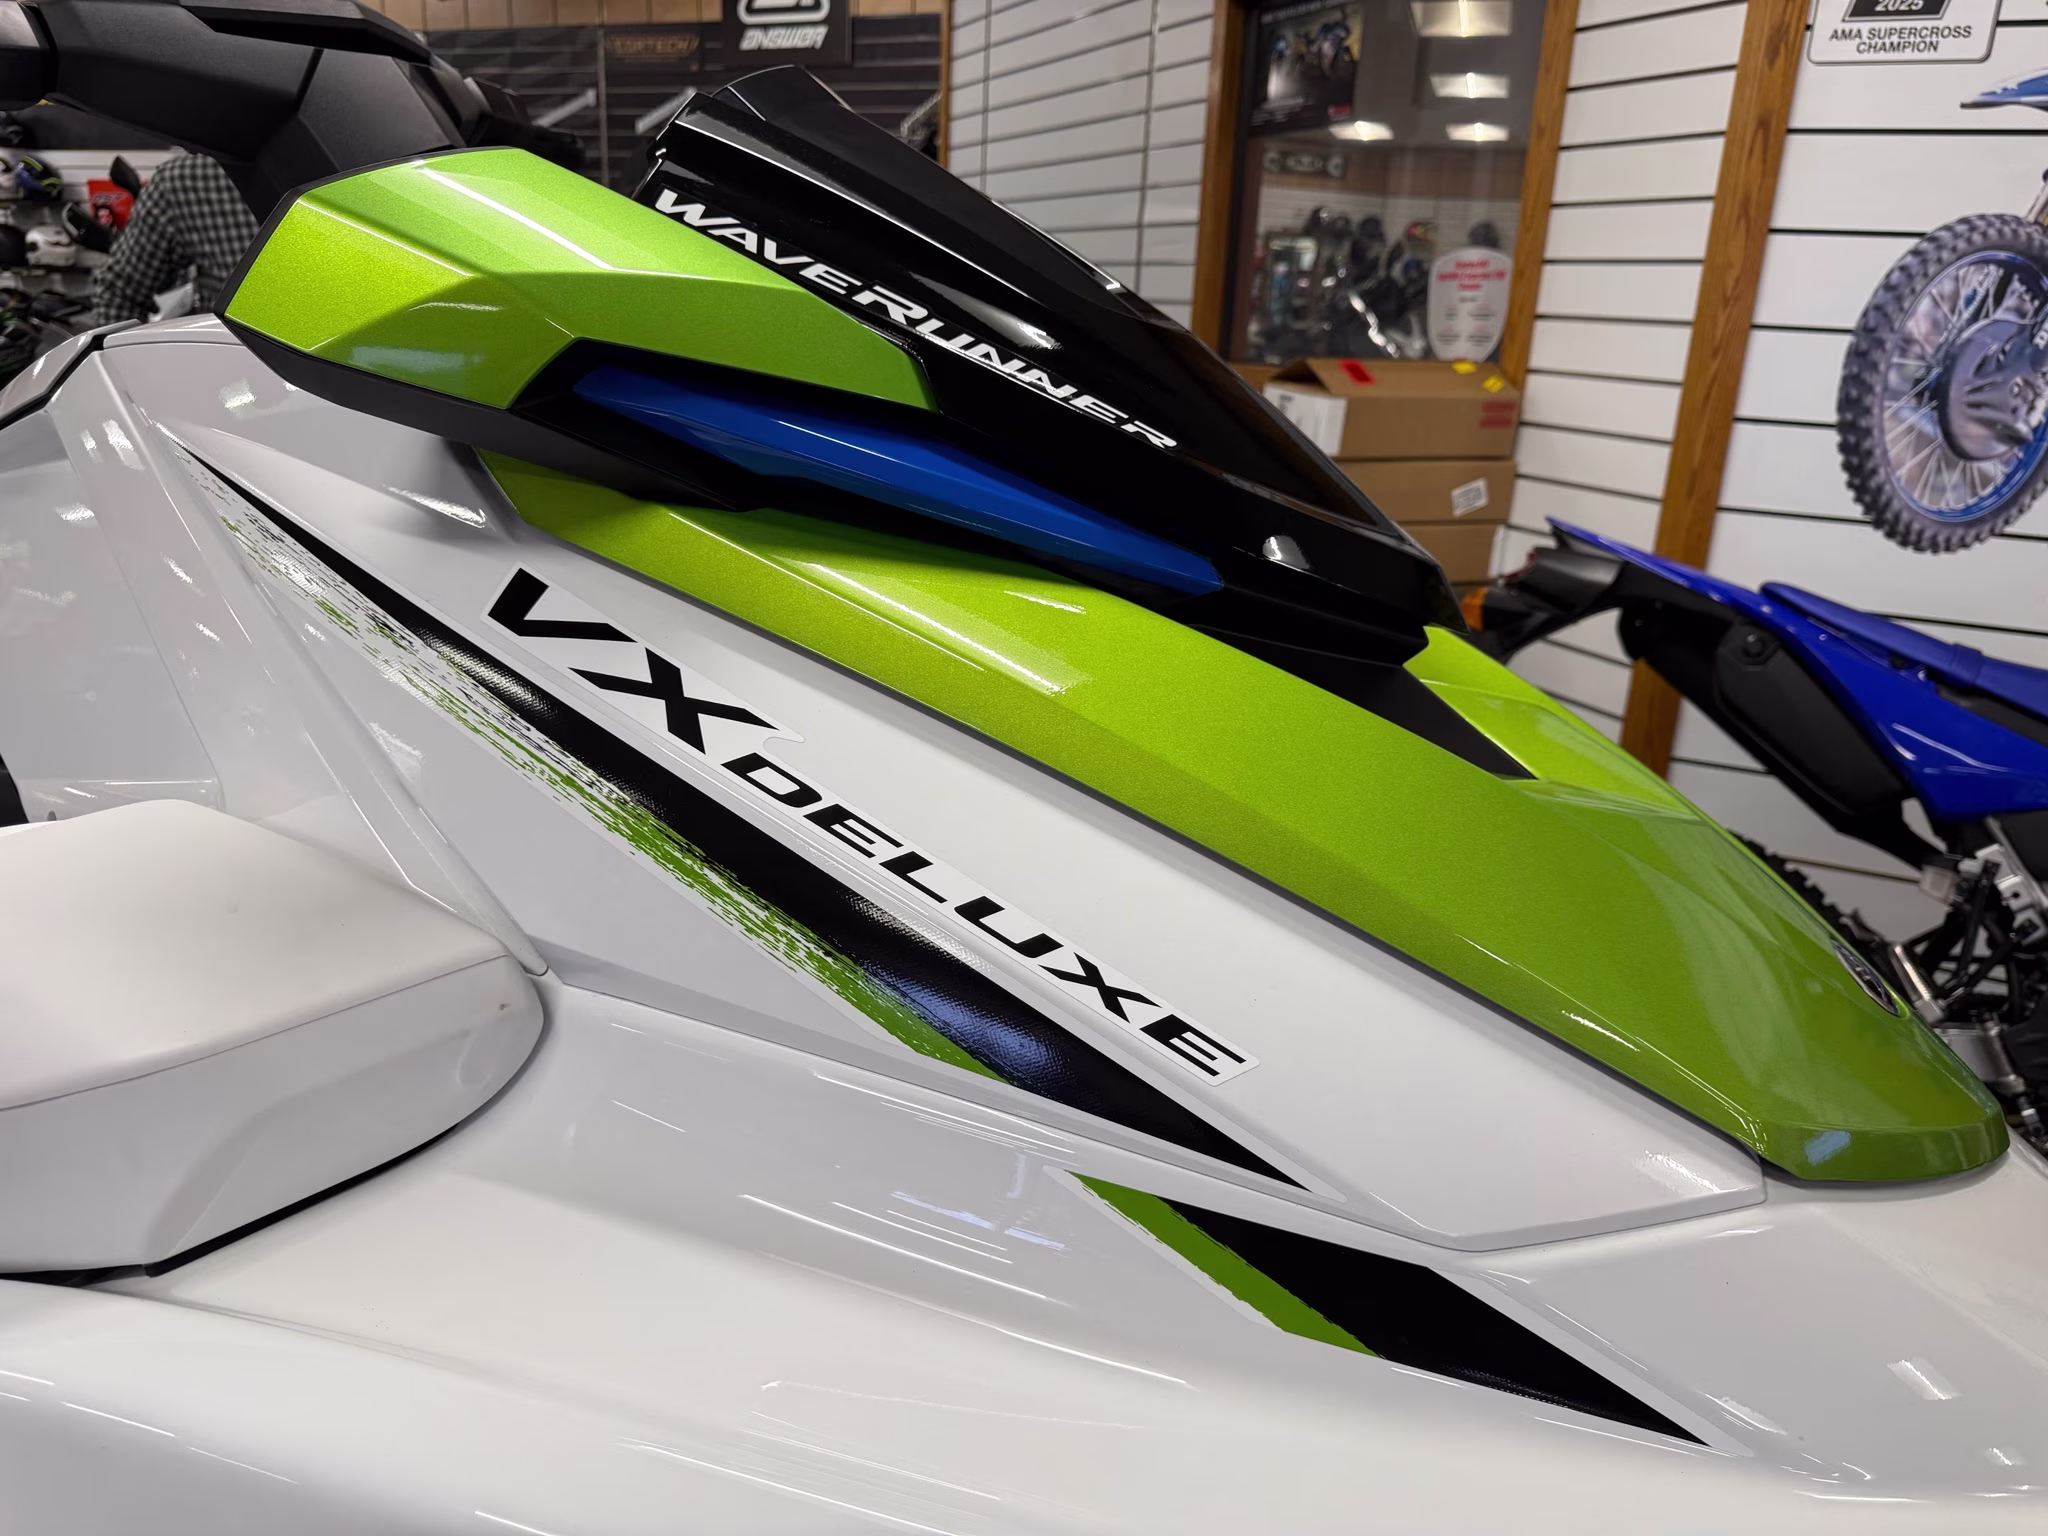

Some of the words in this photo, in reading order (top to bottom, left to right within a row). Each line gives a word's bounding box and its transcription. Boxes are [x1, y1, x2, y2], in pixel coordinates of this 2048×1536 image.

[1875, 0, 1924, 11] 2025
[1828, 28, 1864, 41] AMA
[1866, 26, 1972, 41] SUPERCROSS
[1856, 40, 1939, 54] CHAMPION
[655, 188, 1178, 449] WAVERUNNER
[487, 567, 779, 755] VX
[719, 751, 1247, 1077] DELUXE
